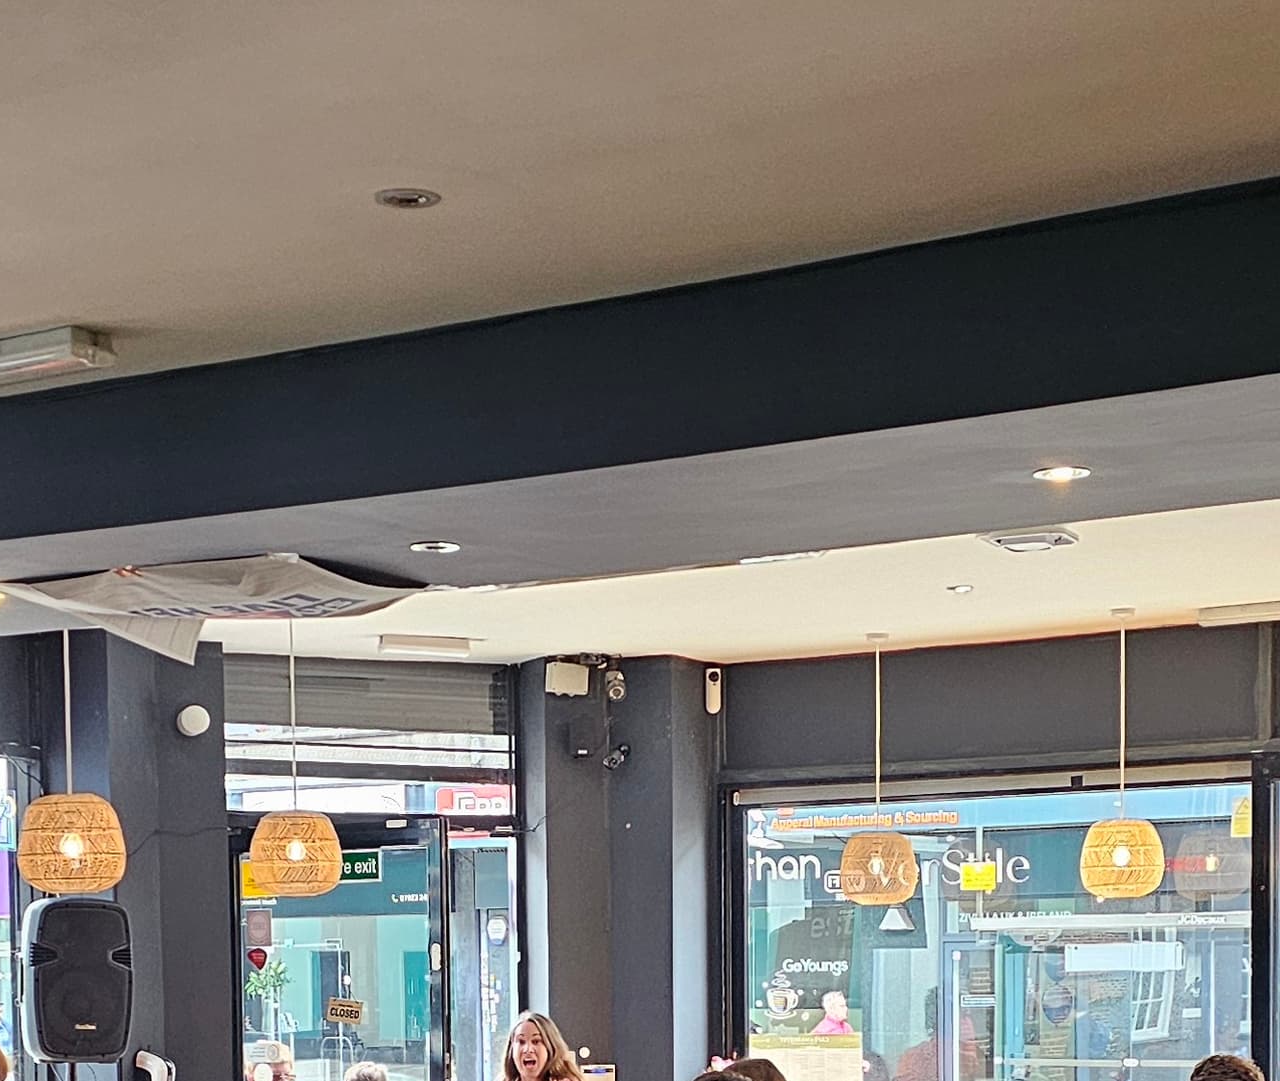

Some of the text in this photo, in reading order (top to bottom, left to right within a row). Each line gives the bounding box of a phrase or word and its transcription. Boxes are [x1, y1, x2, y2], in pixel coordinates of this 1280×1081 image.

[905, 809, 959, 825] Sourcing
[354, 857, 377, 874] exit
[1178, 914, 1227, 925] JCDecaux
[782, 958, 849, 977] GoYoungs
[330, 1007, 360, 1019] CLOSED
